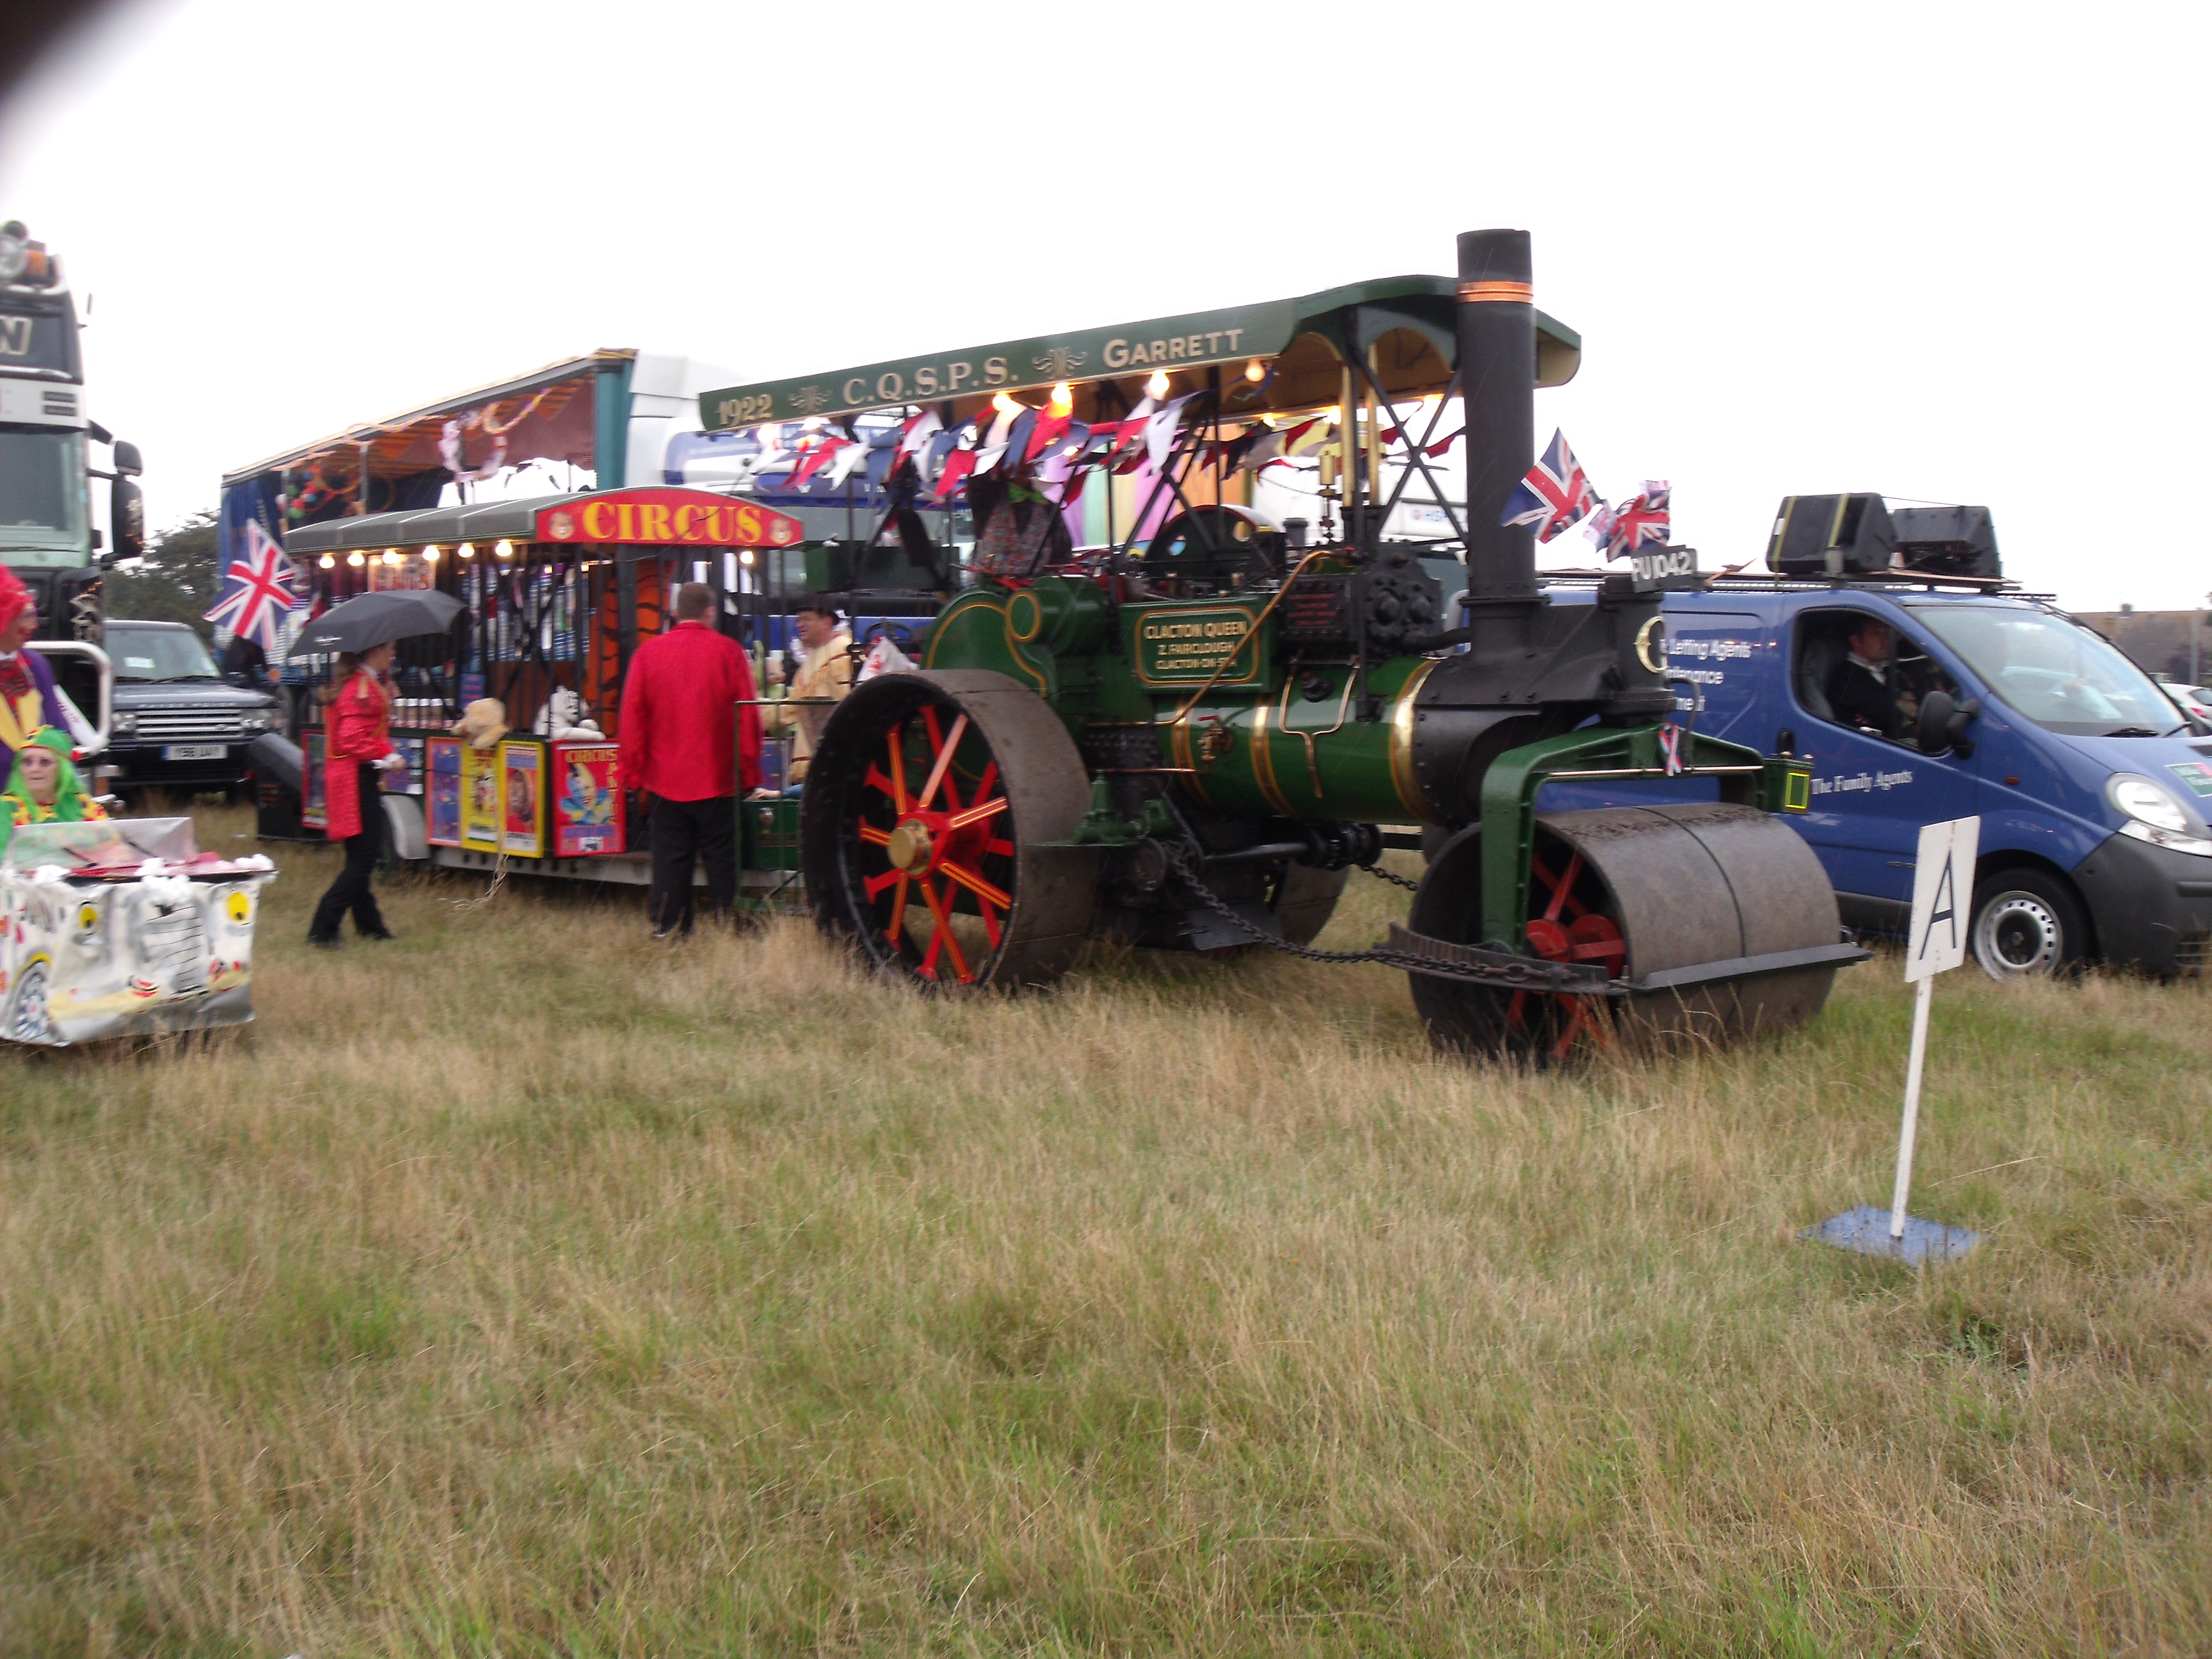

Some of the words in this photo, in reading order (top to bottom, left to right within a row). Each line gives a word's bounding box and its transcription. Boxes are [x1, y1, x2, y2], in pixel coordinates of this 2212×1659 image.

[715, 394, 774, 426] 1922
[842, 357, 1019, 406] C.Q.S.P.S.
[582, 501, 762, 543] CIRCUS
[1144, 624, 1203, 640] CLACTON
[1203, 622, 1247, 638] QUEEN
[1669, 638, 1709, 660] Letting
[1709, 640, 1752, 662] Agents
[1811, 778, 1833, 795] The
[1833, 773, 1874, 793] Family
[1873, 769, 1914, 791] Agents
[1918, 849, 1957, 961] A
